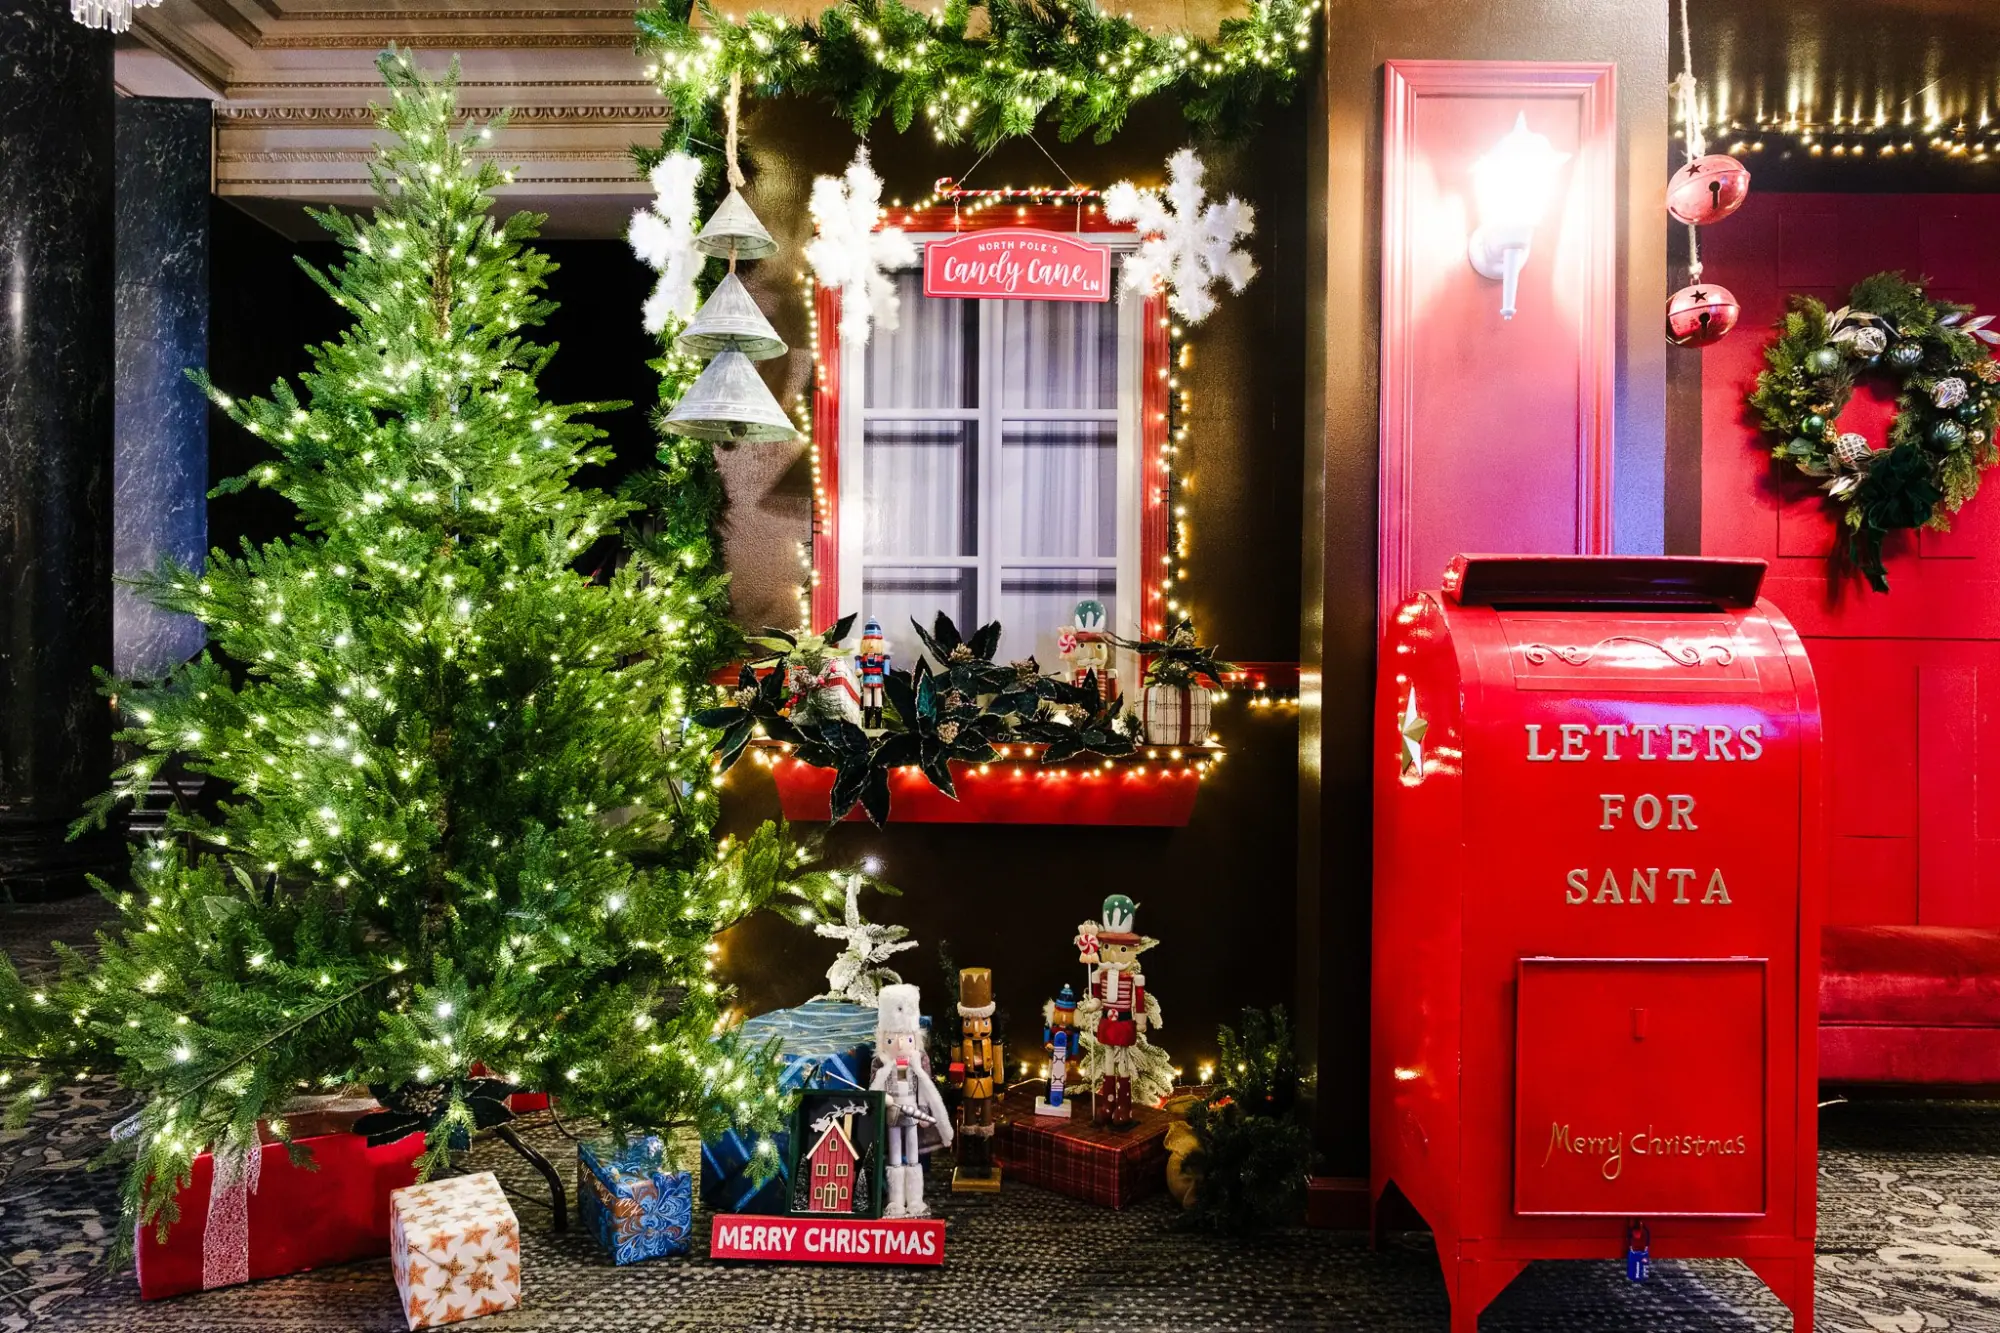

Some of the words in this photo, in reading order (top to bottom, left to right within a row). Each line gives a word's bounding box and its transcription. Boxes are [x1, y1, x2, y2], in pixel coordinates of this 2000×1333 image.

[978, 240, 1015, 252] NORTH
[1019, 240, 1058, 255] POLE'S
[943, 250, 1024, 293] Candy
[1027, 257, 1088, 287] Cane
[1082, 279, 1099, 291] LN
[1524, 723, 1763, 762] LETTERS
[1599, 793, 1699, 831] FOR
[1565, 867, 1733, 905] SANTA
[1541, 1121, 1623, 1180] Merry
[717, 1225, 798, 1252] MERRY
[803, 1226, 936, 1256] CHRISTMAS
